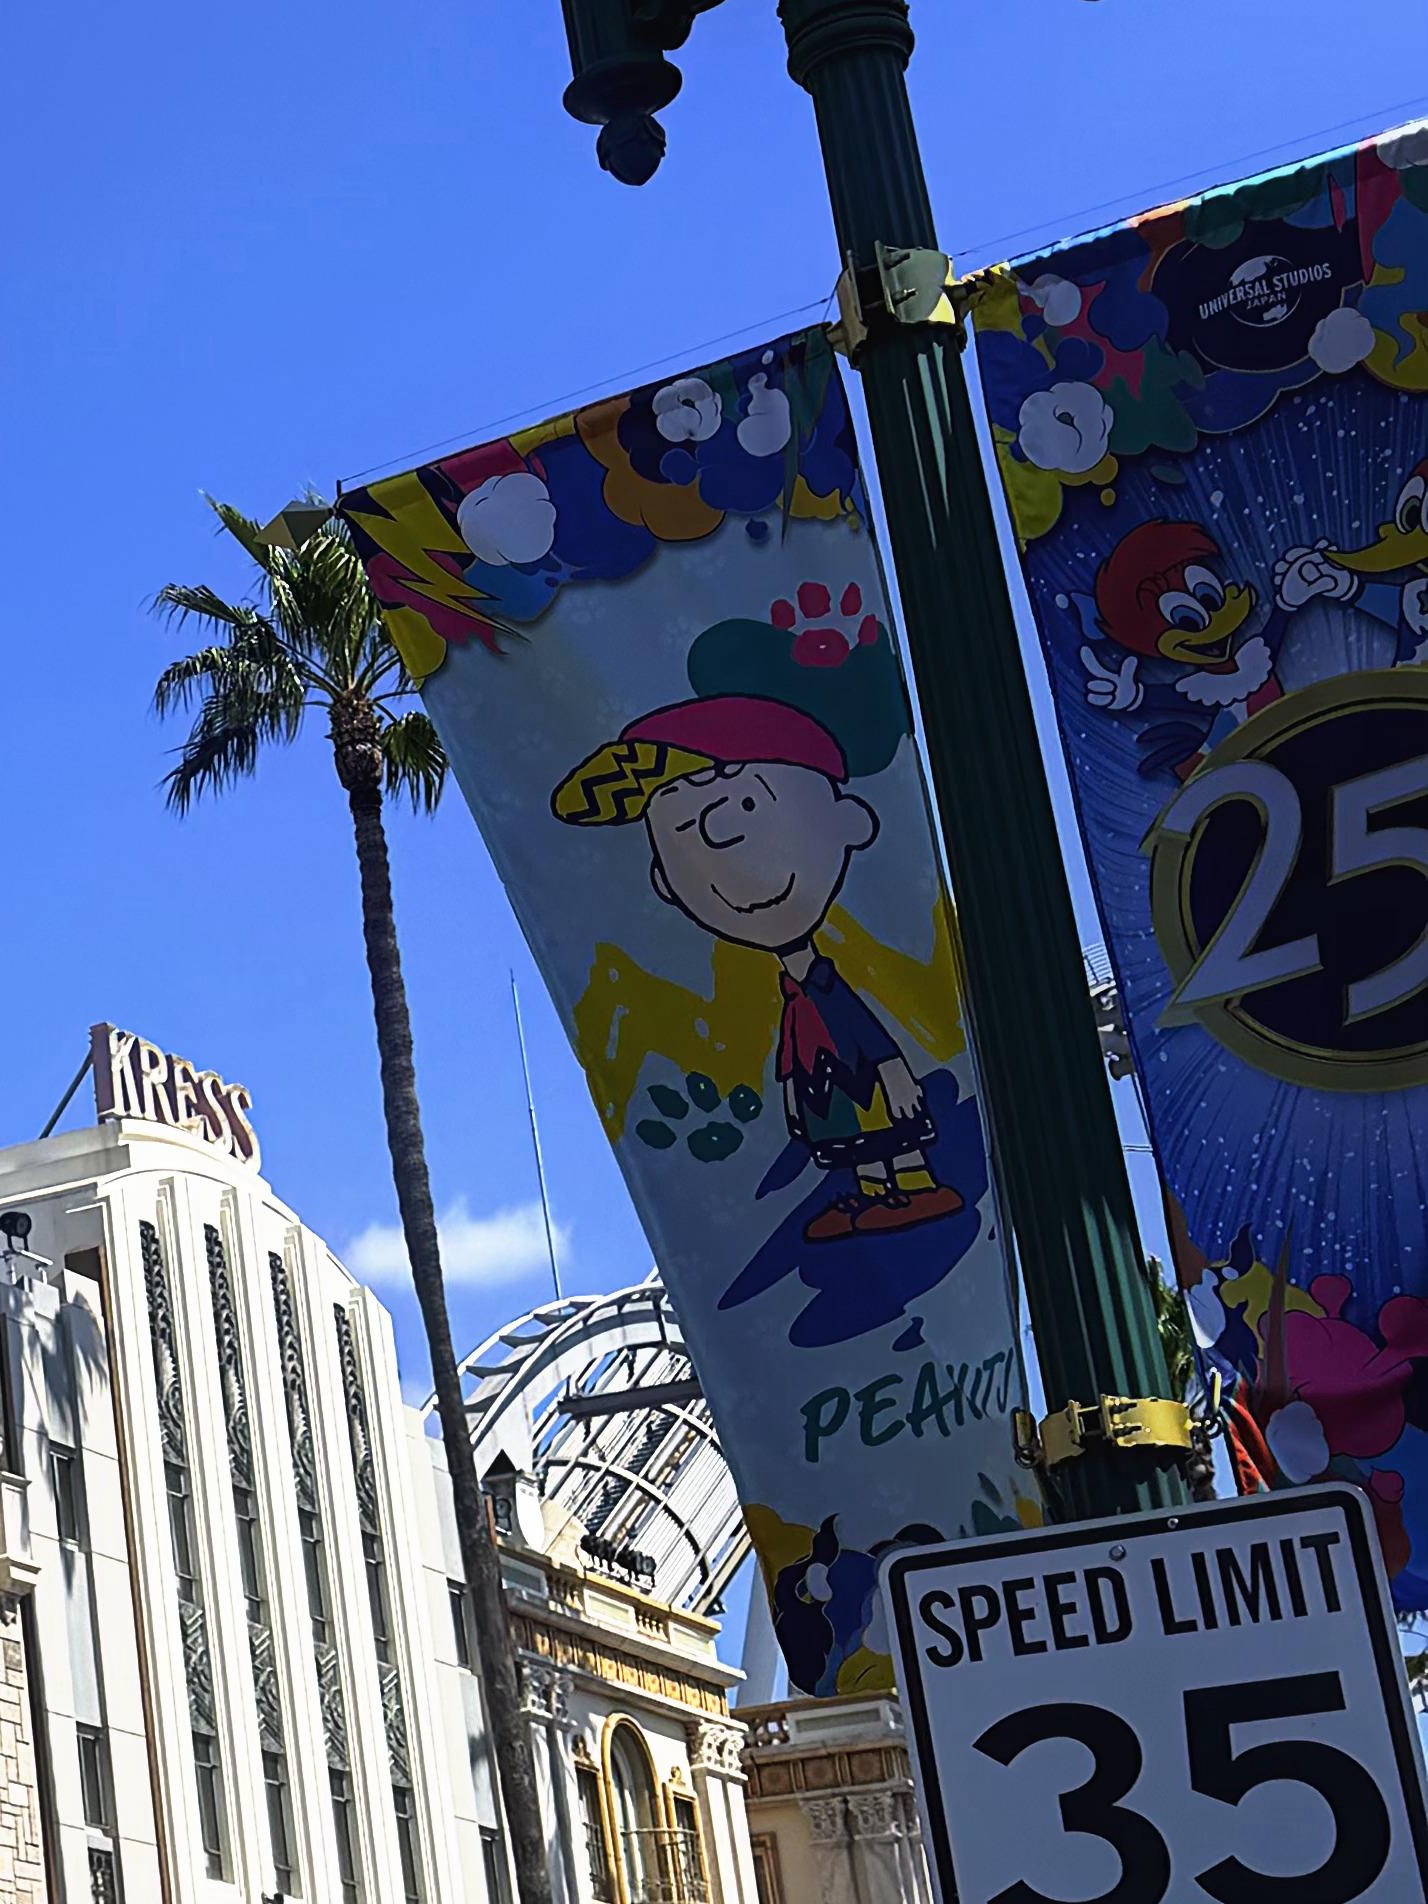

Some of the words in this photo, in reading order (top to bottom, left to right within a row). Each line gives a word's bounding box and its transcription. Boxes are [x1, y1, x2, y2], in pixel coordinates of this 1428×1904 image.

[1199, 280, 1270, 320] UNIVERSAL
[1272, 263, 1332, 292] STUDIOS
[1246, 292, 1286, 309] JAPAN
[104, 1023, 262, 1174] KRESS
[800, 1347, 1014, 1463] PEANT
[919, 1565, 1132, 1668] SPEED
[1150, 1531, 1343, 1638] LIMIT
